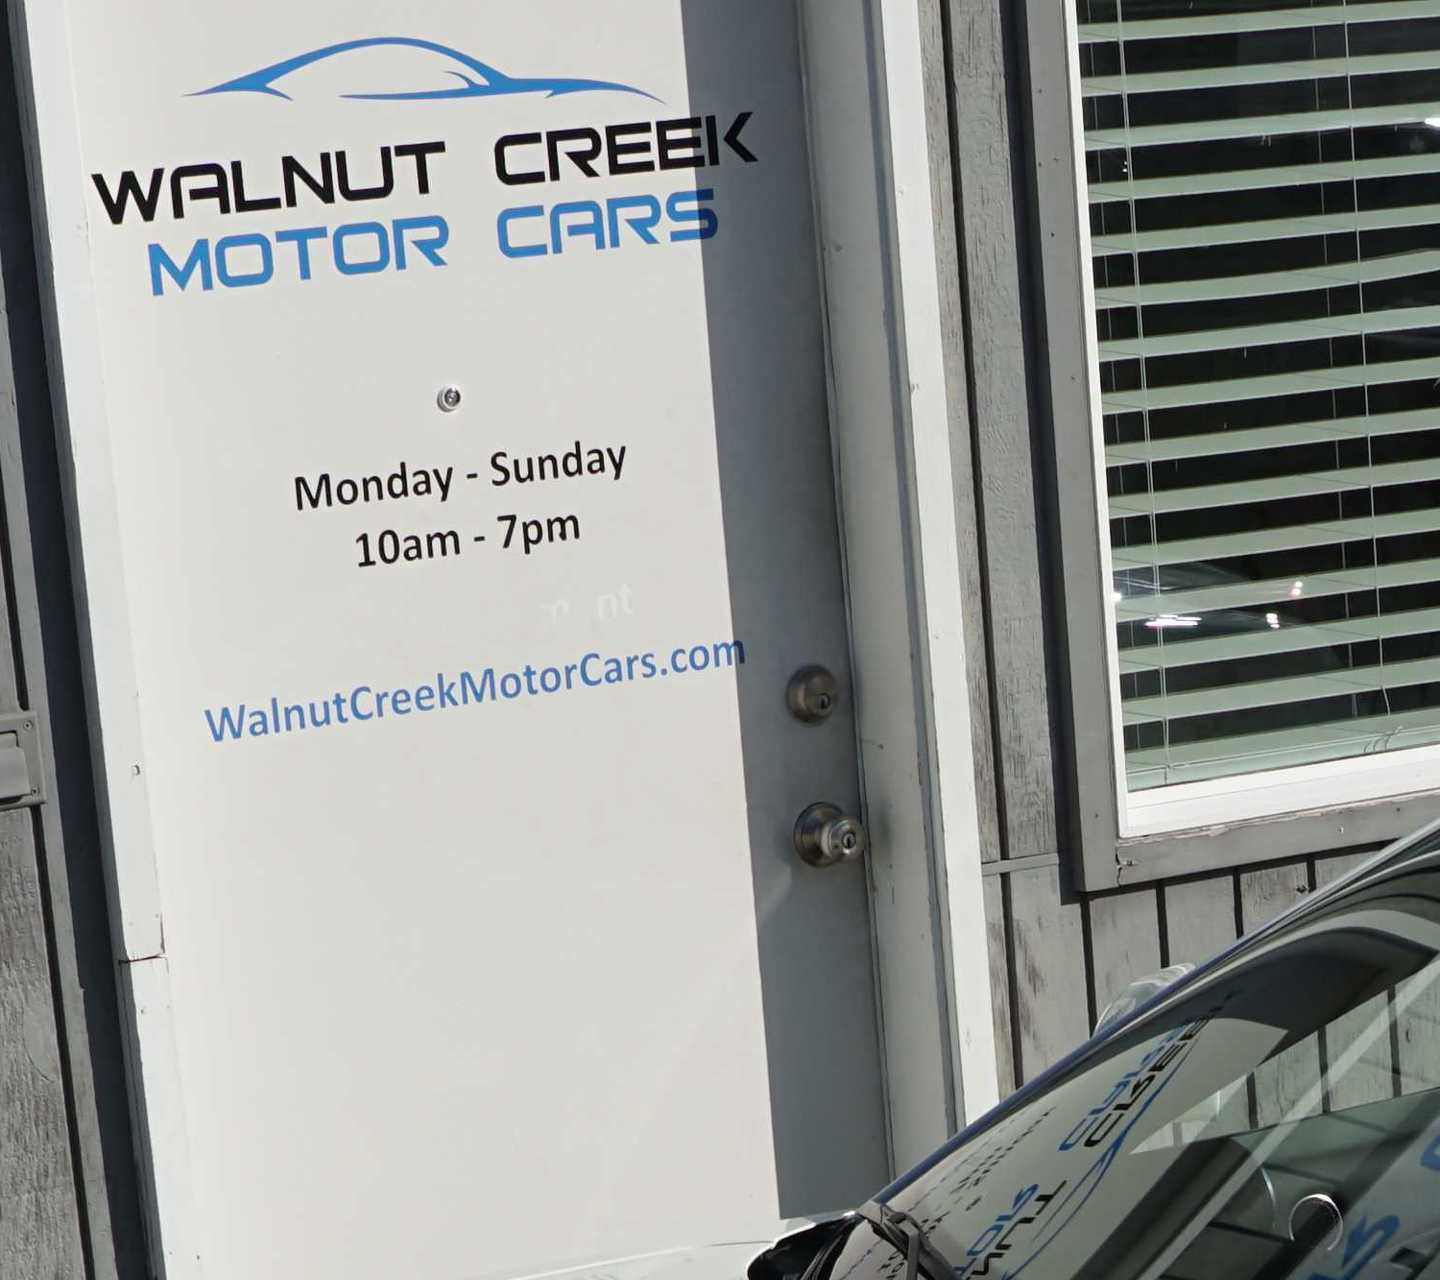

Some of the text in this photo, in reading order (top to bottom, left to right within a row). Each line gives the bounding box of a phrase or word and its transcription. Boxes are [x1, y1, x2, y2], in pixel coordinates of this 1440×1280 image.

[90, 111, 759, 226] WALNUT CREEK
[147, 187, 719, 297] MOTOR CARS
[294, 461, 454, 512] Monday
[490, 439, 627, 487] Sunday
[355, 529, 461, 568] 10am
[496, 513, 581, 556] 7pm
[204, 638, 746, 742] WalnutCreekMotorCars.com
